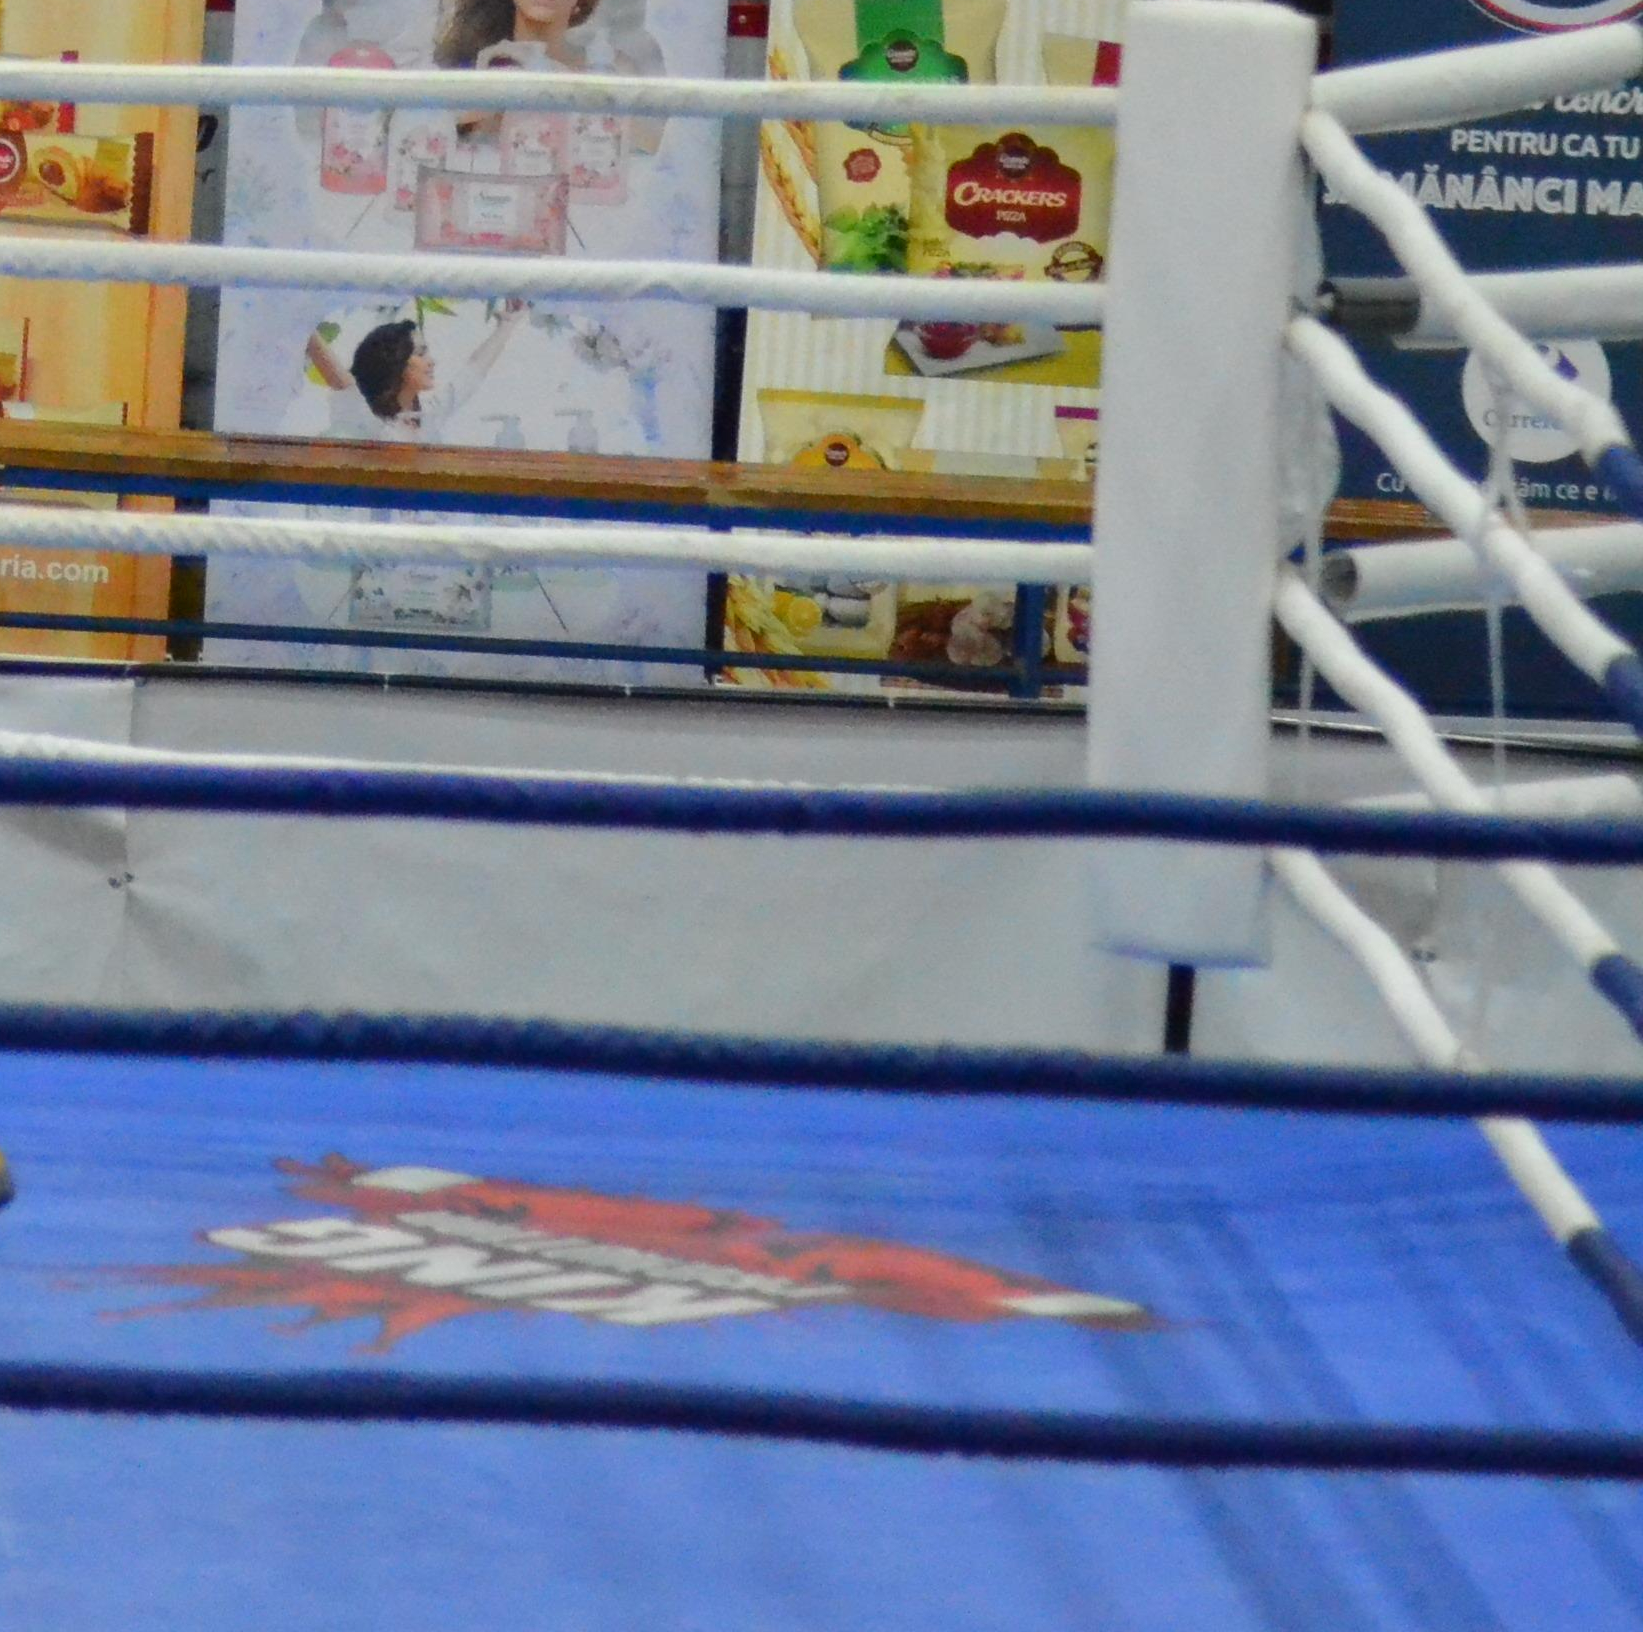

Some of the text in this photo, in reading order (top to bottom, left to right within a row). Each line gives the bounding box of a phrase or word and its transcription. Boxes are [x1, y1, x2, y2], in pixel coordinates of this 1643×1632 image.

[1450, 129, 1641, 161] PENTRU CA TU
[953, 180, 1068, 209] CRACKERS
